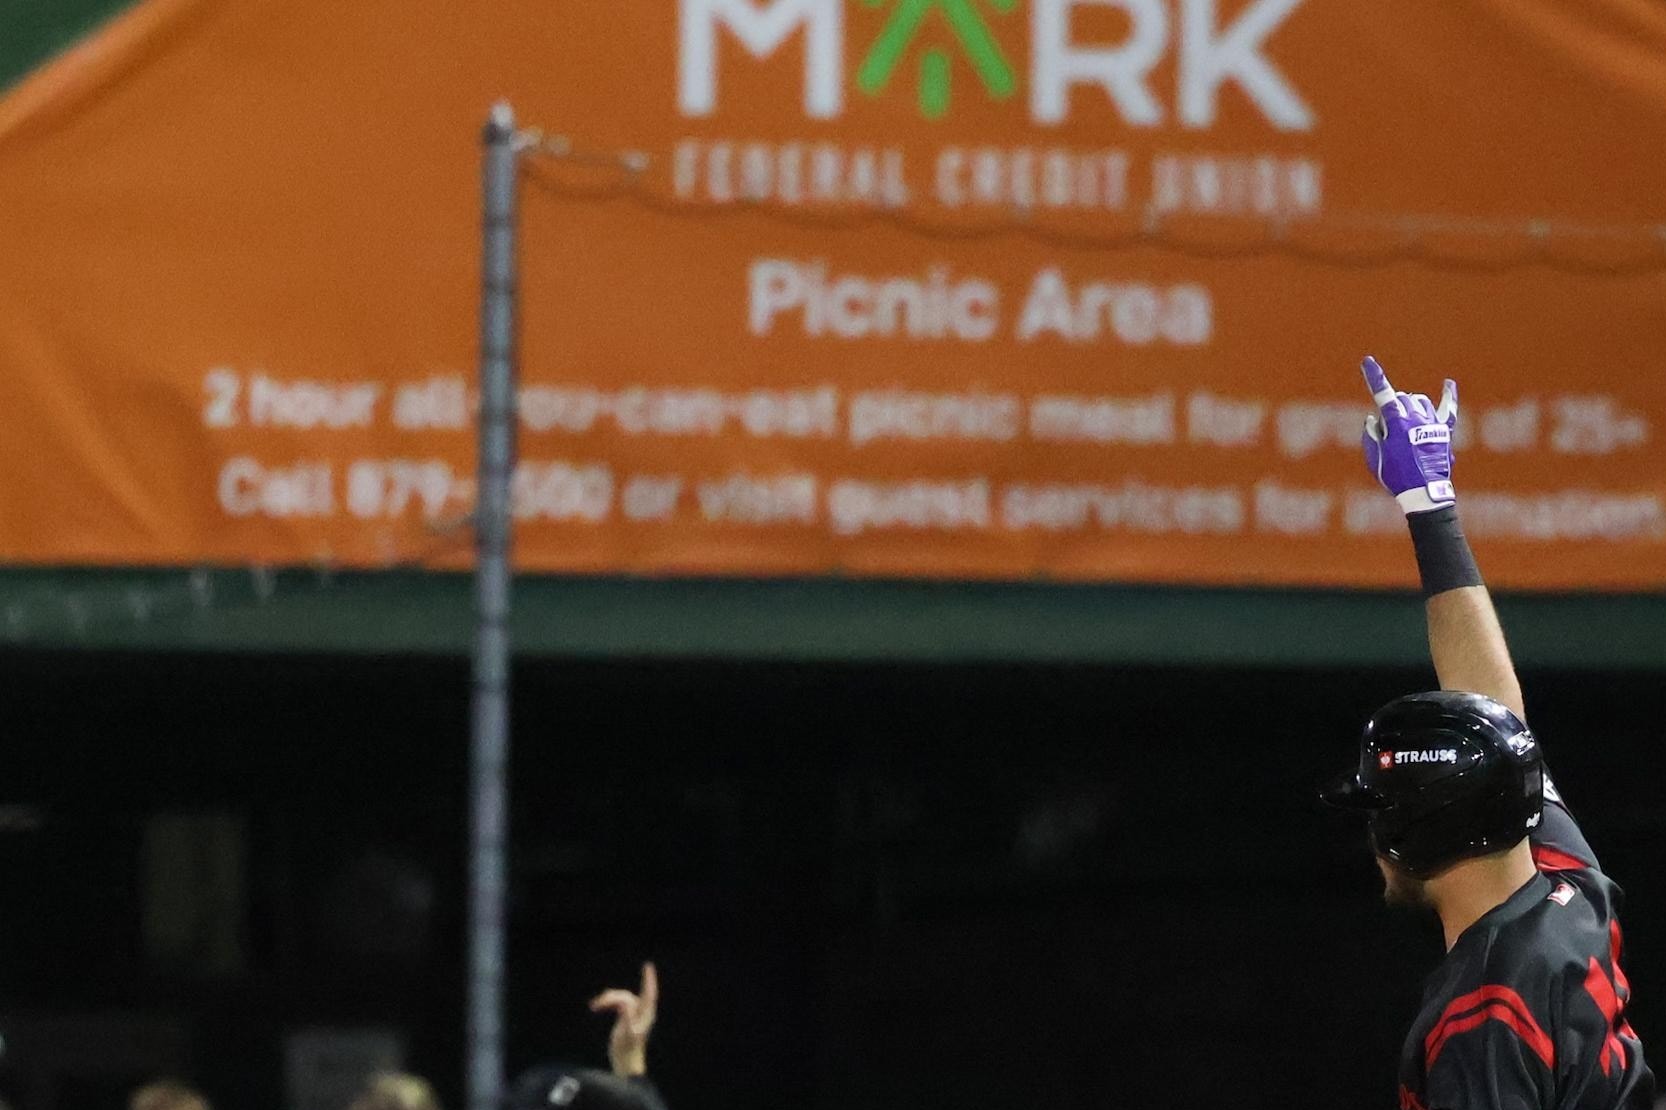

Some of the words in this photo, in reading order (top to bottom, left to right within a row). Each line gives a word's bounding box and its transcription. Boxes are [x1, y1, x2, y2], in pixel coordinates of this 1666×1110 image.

[674, 142, 910, 206] FEDERAL
[935, 147, 1128, 211] CREDIT
[748, 258, 998, 340] Picnic
[1015, 265, 1213, 344] Area
[203, 368, 239, 429] 2
[249, 372, 380, 429] hour
[850, 384, 1017, 448] picnic
[1030, 392, 1174, 443] meal
[1187, 392, 1265, 446] for
[1482, 396, 1540, 452] of
[217, 456, 334, 519] Call
[622, 473, 685, 521] or
[697, 468, 816, 527] visit
[829, 474, 988, 537] guest
[1003, 476, 1243, 534] services
[1255, 478, 1330, 536] for
[1395, 750, 1456, 764] STRAUSS
